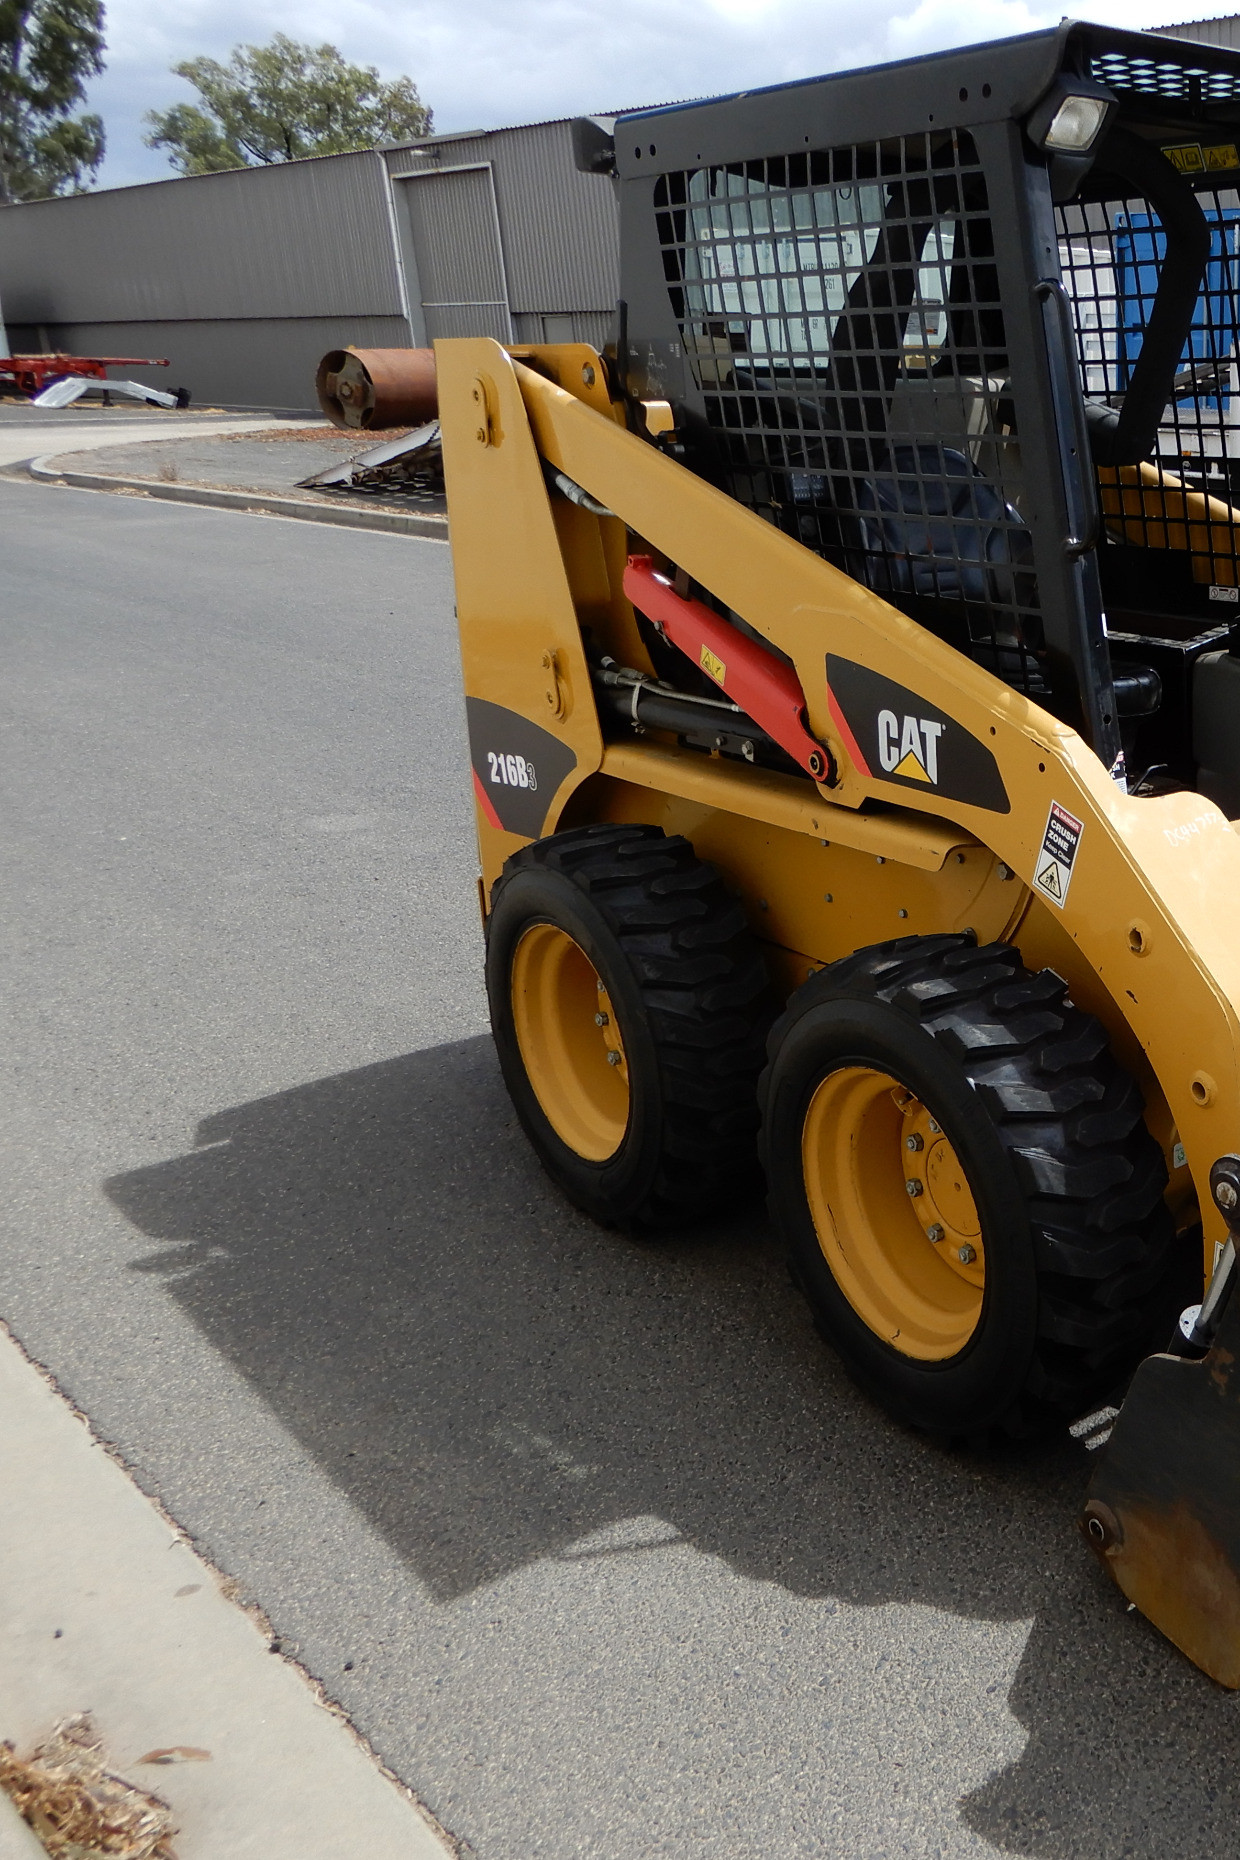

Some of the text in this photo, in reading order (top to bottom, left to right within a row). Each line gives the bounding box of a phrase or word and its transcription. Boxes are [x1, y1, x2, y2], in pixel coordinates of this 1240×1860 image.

[877, 709, 942, 786] CAT
[1050, 819, 1077, 845] CRUSH
[1059, 811, 1080, 832] DANGER
[1045, 840, 1071, 865] Keep Clear
[1047, 829, 1069, 852] ZONE
